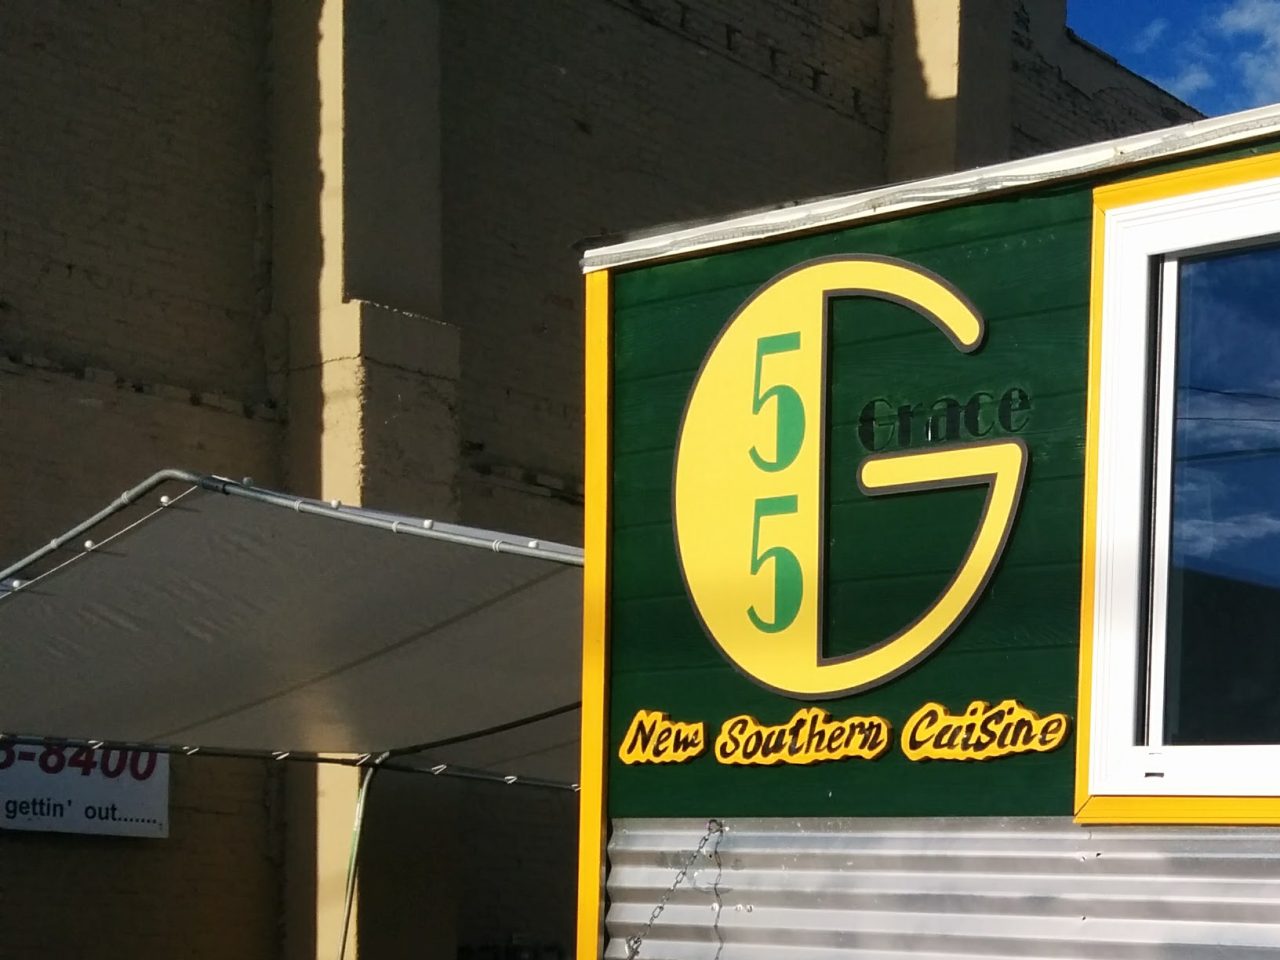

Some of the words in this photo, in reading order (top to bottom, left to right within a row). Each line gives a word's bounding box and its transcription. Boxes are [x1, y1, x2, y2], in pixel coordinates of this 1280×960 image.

[857, 386, 1033, 452] Grace
[625, 718, 702, 755] New
[720, 709, 884, 758] Southern
[5, 797, 72, 820] gettin'
